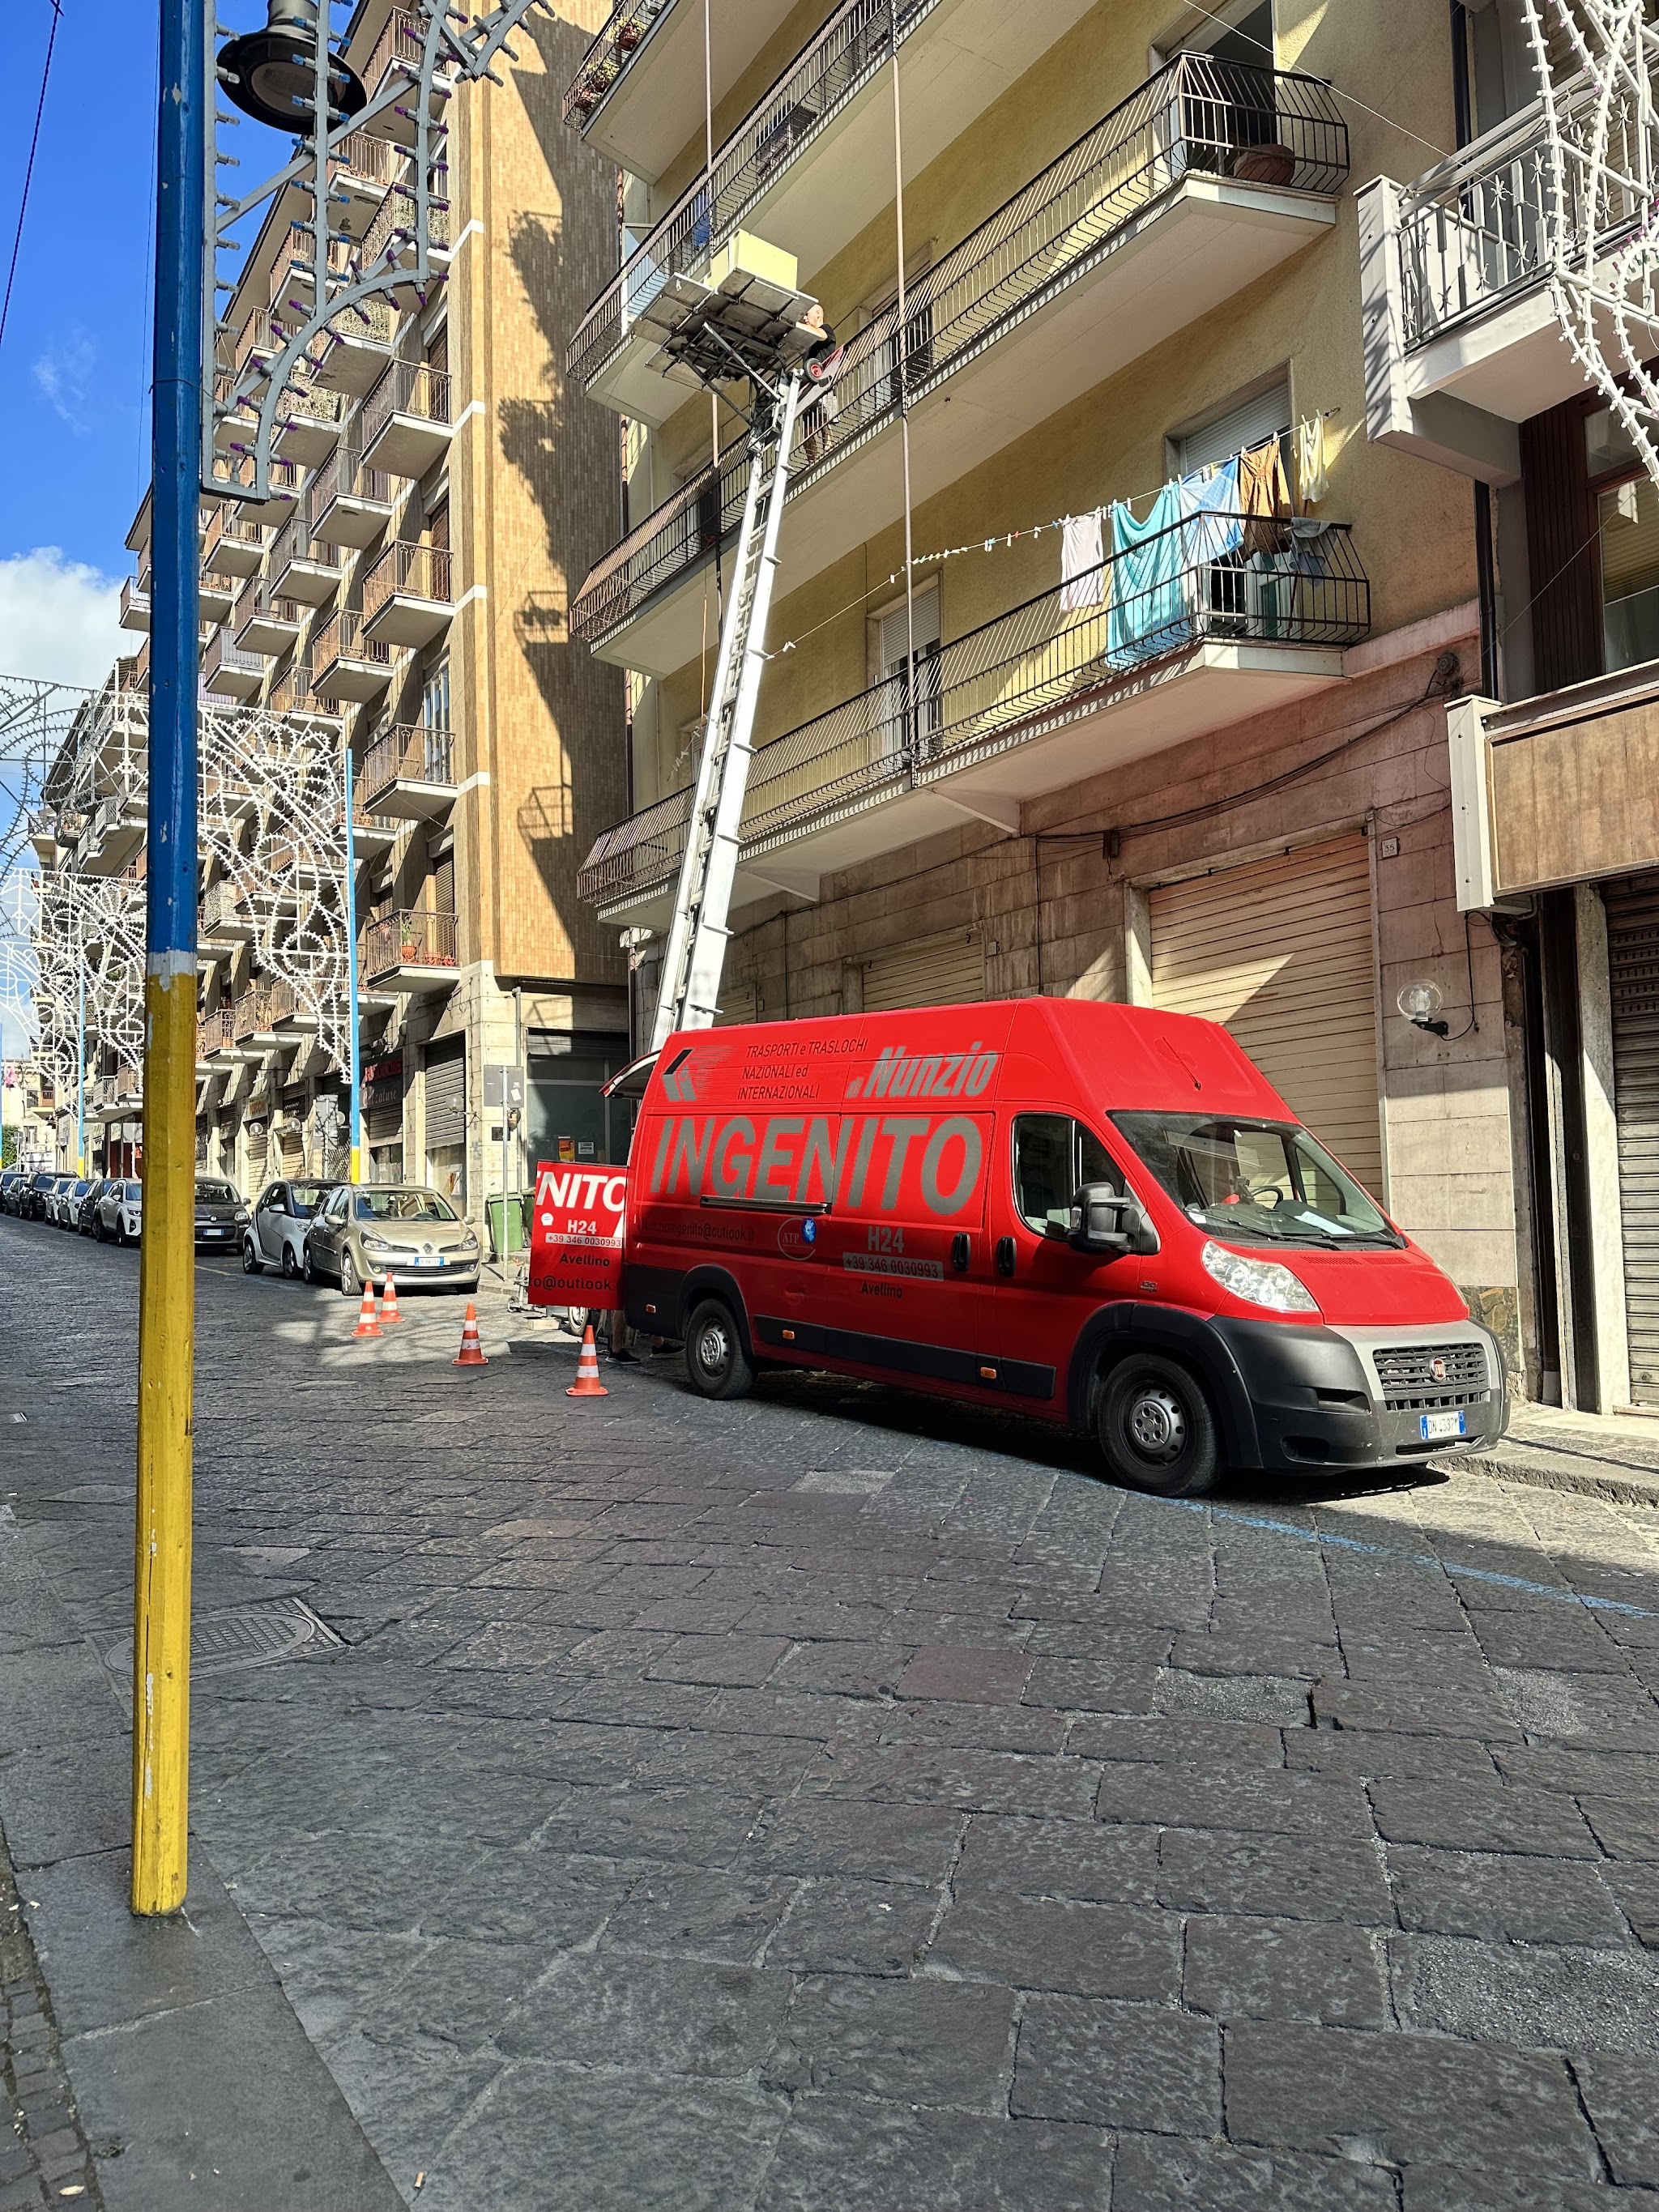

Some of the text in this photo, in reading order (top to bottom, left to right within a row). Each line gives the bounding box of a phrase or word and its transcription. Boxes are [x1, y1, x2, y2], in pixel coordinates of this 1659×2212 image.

[1384, 844, 1395, 853] 35
[746, 1038, 869, 1059] TRASPORTI e TRASLOCHI
[742, 1063, 809, 1080] NAZIONALI ed
[863, 1041, 998, 1098] Nunzio
[737, 1085, 821, 1101] INTERNAZIONALI
[650, 1116, 983, 1214] INGENITO
[536, 1170, 627, 1212] NITO
[567, 1219, 597, 1235] H24
[548, 1234, 621, 1247] +39 346 0030993
[868, 1225, 905, 1254] H24
[560, 1252, 611, 1267] Avellino
[846, 1255, 939, 1278] +39 346 0030993
[861, 1280, 903, 1298] Avellino
